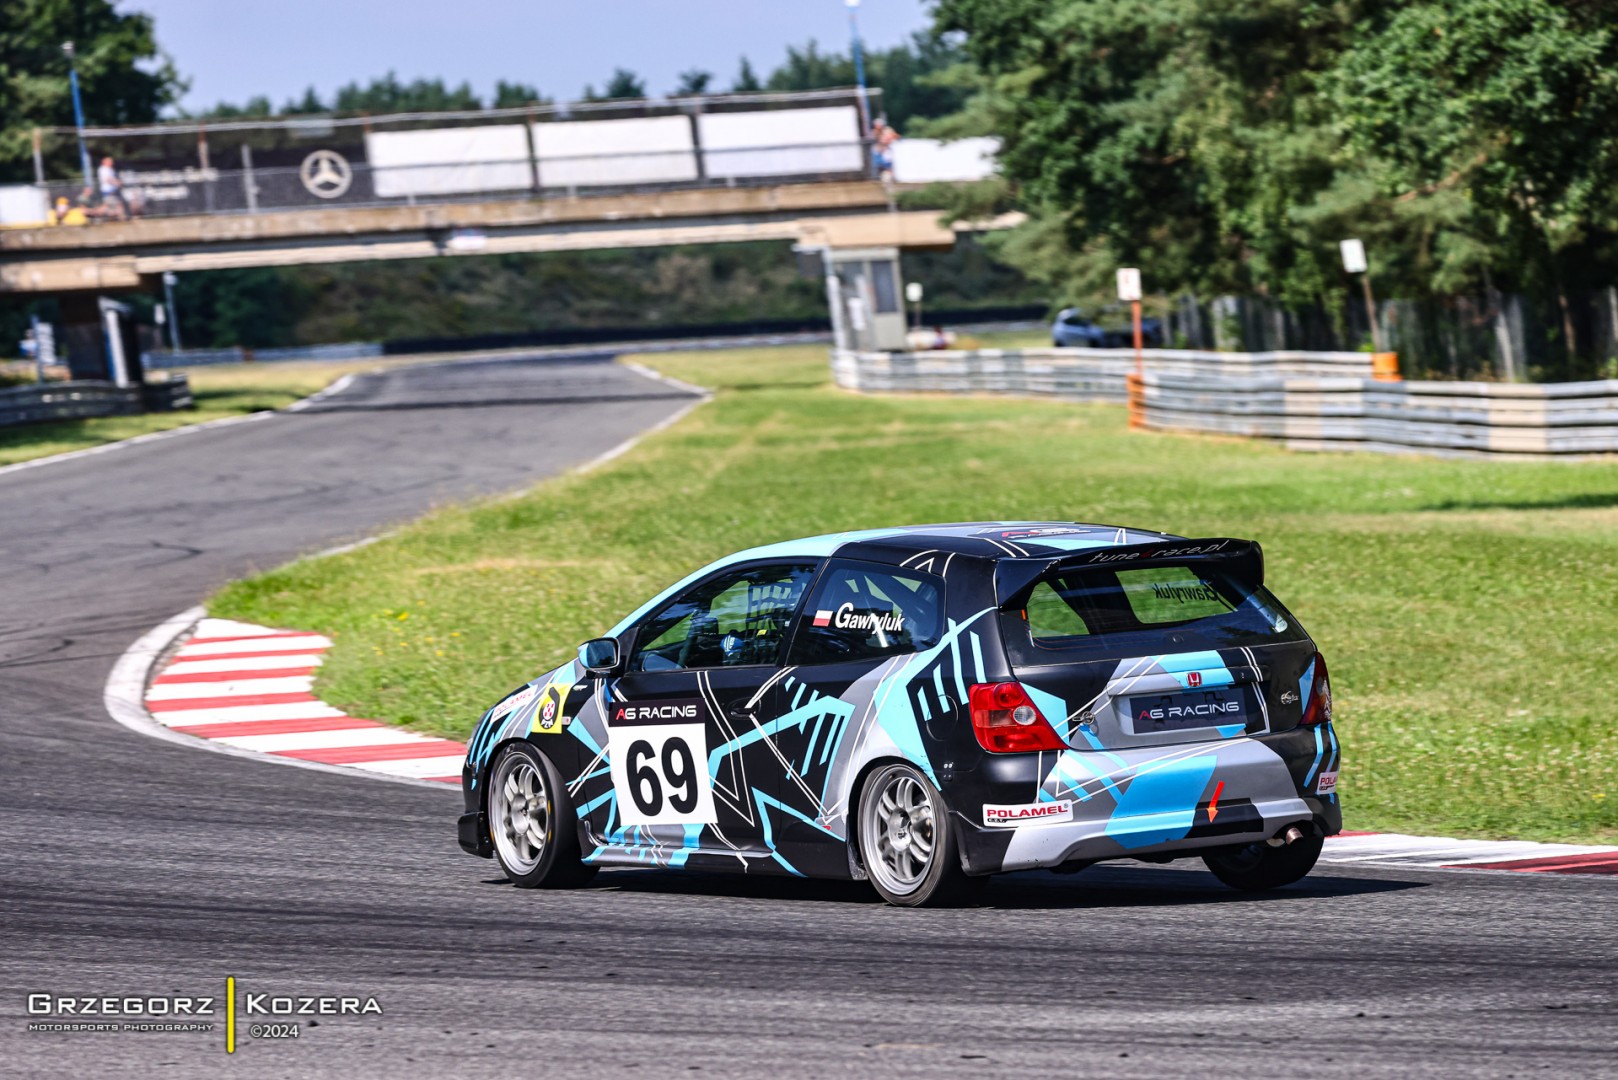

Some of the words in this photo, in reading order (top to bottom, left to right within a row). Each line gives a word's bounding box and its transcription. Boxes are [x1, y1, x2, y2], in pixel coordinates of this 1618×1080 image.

[834, 602, 906, 635] Gawryluk
[615, 707, 636, 720] AG
[638, 704, 698, 719] RACING
[1138, 707, 1164, 721] AG
[1168, 701, 1240, 718] RACING
[626, 736, 699, 817] 69
[986, 805, 1069, 818] POLAMEL
